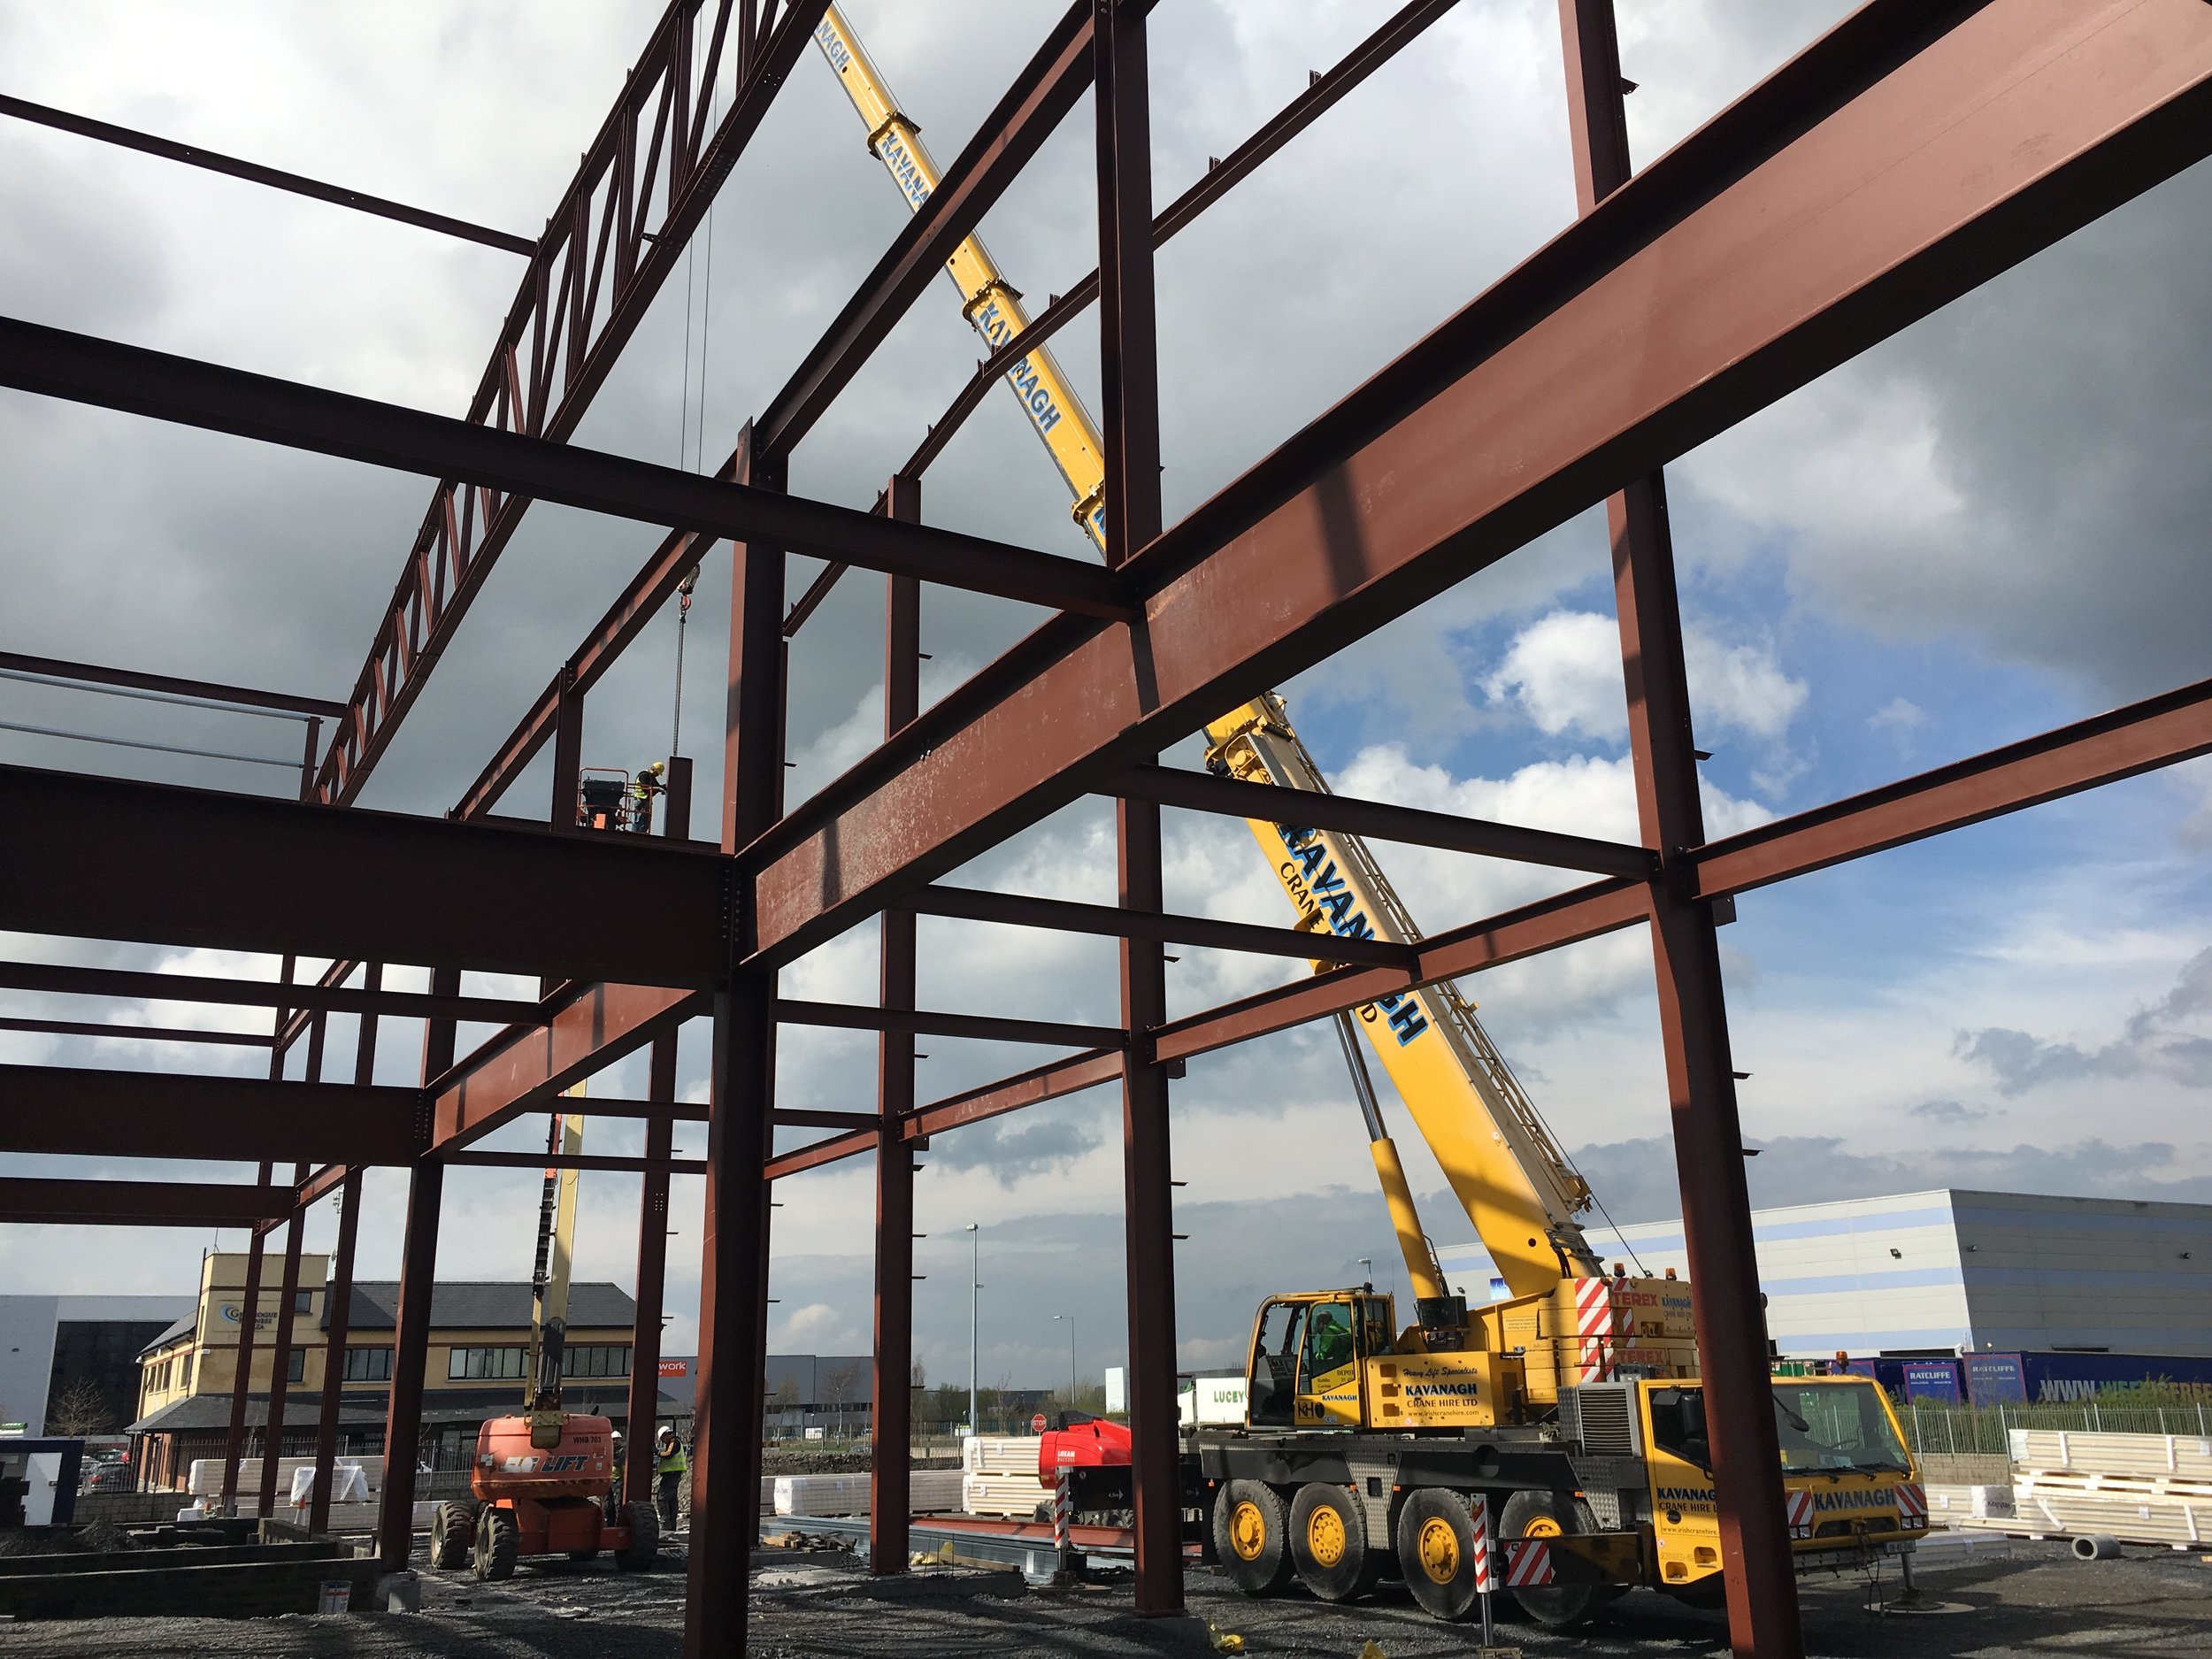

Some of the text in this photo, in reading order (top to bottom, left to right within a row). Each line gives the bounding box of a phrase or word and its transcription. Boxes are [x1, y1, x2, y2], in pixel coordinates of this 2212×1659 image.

[1612, 1291, 1657, 1307] TEREX
[1617, 1348, 1664, 1363] TEREX
[1403, 1366, 1478, 1379] Heavy Lift Specialists
[1213, 1390, 1244, 1403] LUCEY
[1405, 1383, 1478, 1396] KAVANAGH
[540, 1455, 590, 1472] LIFT
[1814, 1488, 1896, 1510] KAVANAGH
[1659, 1502, 1688, 1511] CRANE
[1691, 1503, 1712, 1512] HIRE
